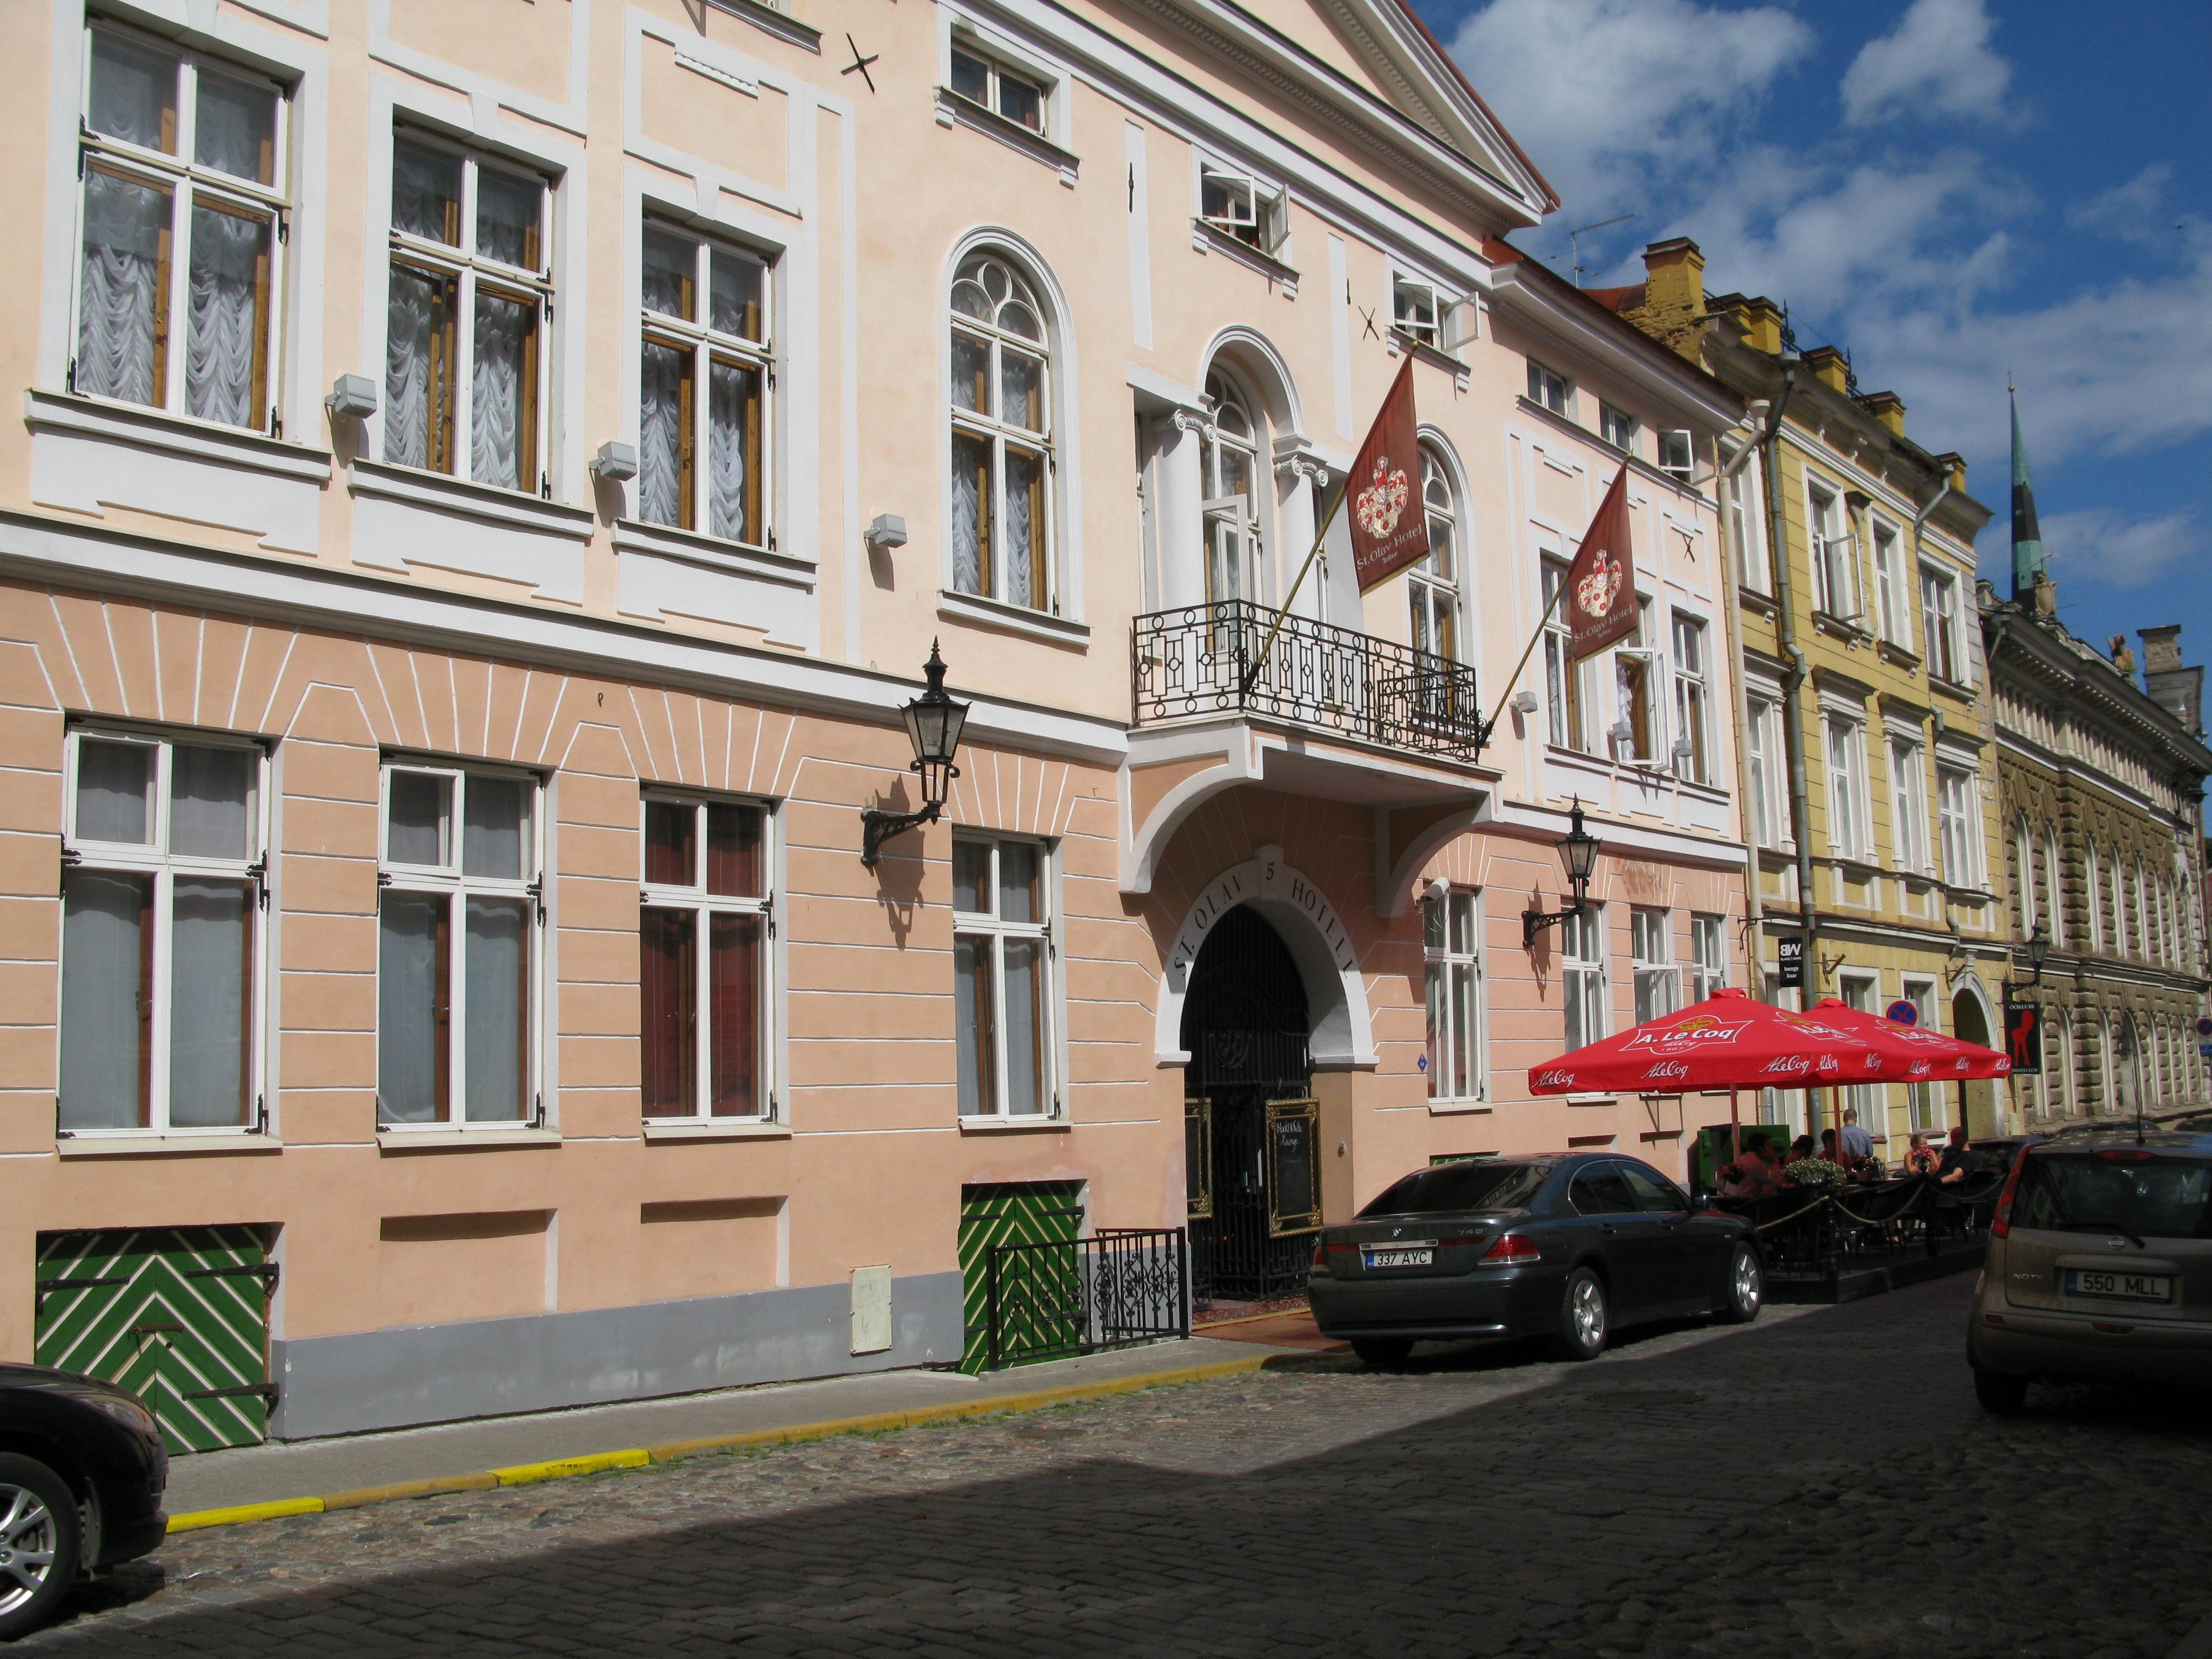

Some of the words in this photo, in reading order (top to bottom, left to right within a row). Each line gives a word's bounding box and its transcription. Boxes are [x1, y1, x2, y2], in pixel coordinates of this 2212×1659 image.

[1394, 523, 1422, 547] Hotel
[1609, 604, 1632, 624] Hotel
[1266, 862, 1275, 881] 5
[1194, 872, 1241, 930] OLAV
[1292, 878, 1353, 978] HOTELL
[1692, 1029, 1735, 1040] Coq
[1378, 1253, 1397, 1265] 337
[1402, 1251, 1427, 1264] AYC
[2084, 1274, 2115, 1292] 550
[2125, 1277, 2161, 1296] MLL
